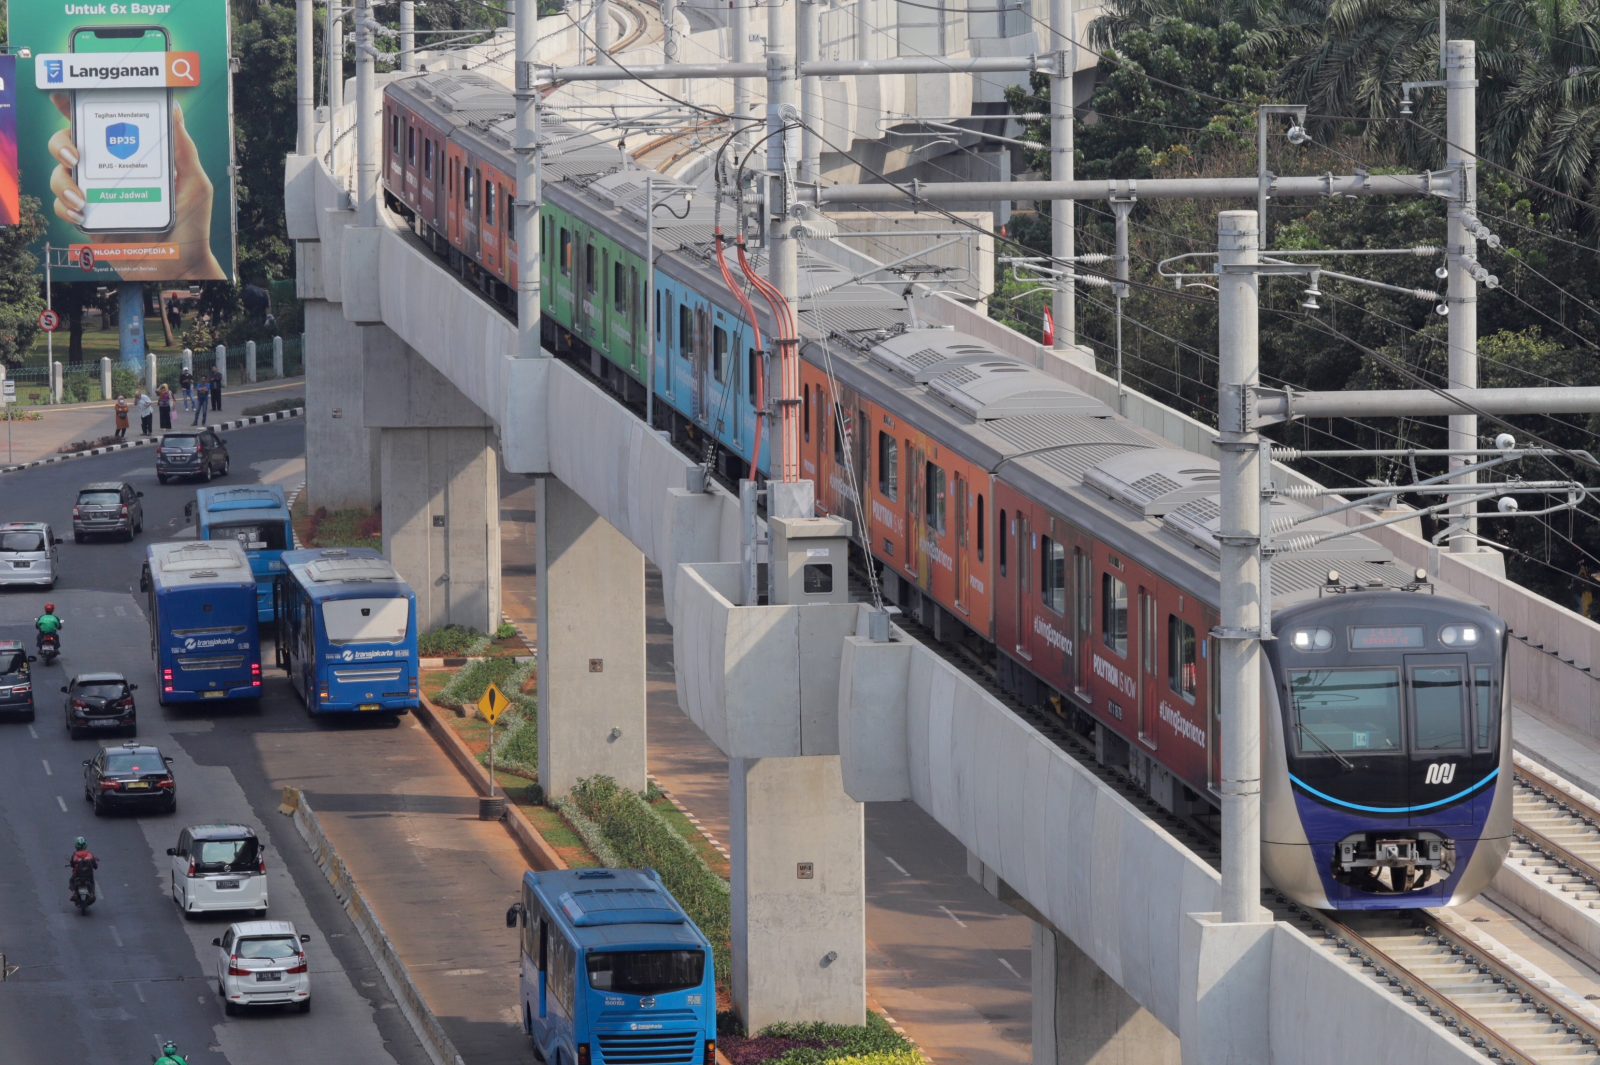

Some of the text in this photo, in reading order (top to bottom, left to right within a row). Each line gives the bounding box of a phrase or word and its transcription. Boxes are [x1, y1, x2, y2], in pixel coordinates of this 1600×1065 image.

[65, 3, 170, 15] Untuk 6x Bayar
[69, 64, 159, 80] Langganan
[109, 136, 136, 145] BPJS
[99, 190, 148, 200] Atur Jadwal
[123, 247, 166, 255] TOKOPEDIA
[197, 637, 235, 647] transjakarta
[355, 650, 394, 659] transjakarta
